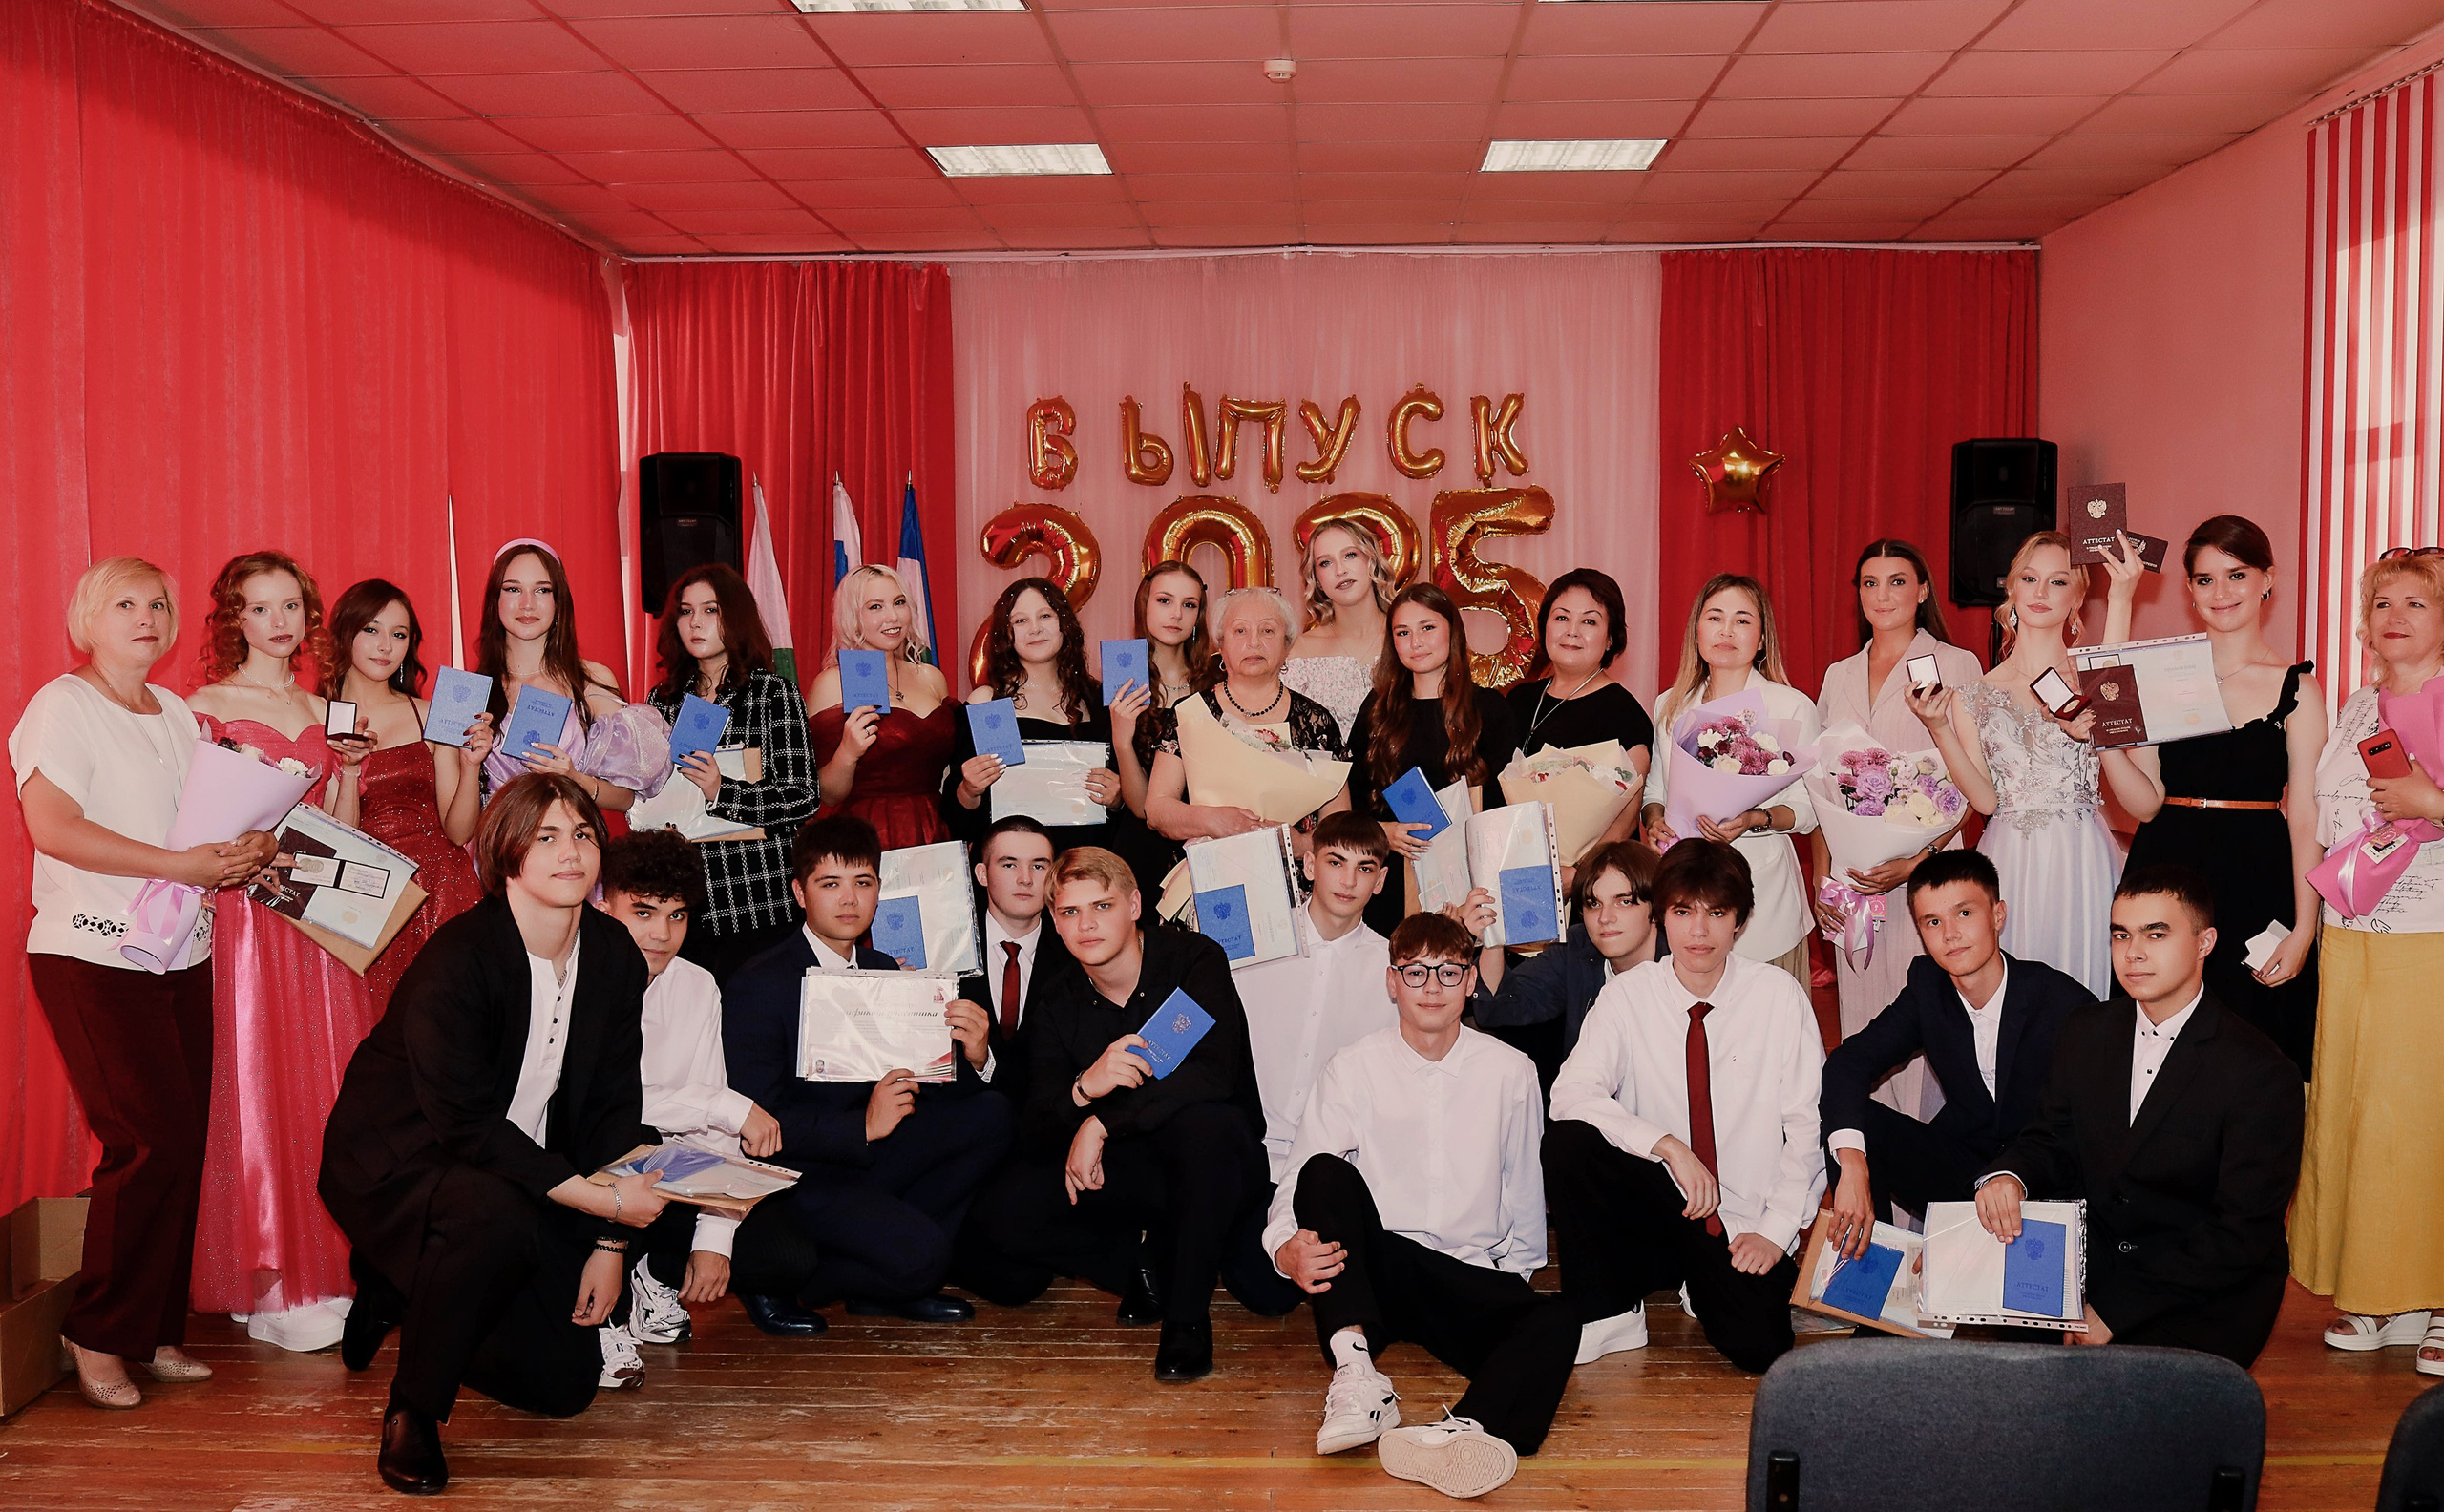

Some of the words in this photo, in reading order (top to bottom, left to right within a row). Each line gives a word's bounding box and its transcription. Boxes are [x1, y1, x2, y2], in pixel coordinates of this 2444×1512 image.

[1027, 384, 1530, 491] ВЫПУСК
[2082, 536, 2116, 545] АТТЕСТАТ
[2101, 718, 2133, 727] АТТЕСТАТ
[2016, 1283, 2050, 1292] АТТЕСТАТ
